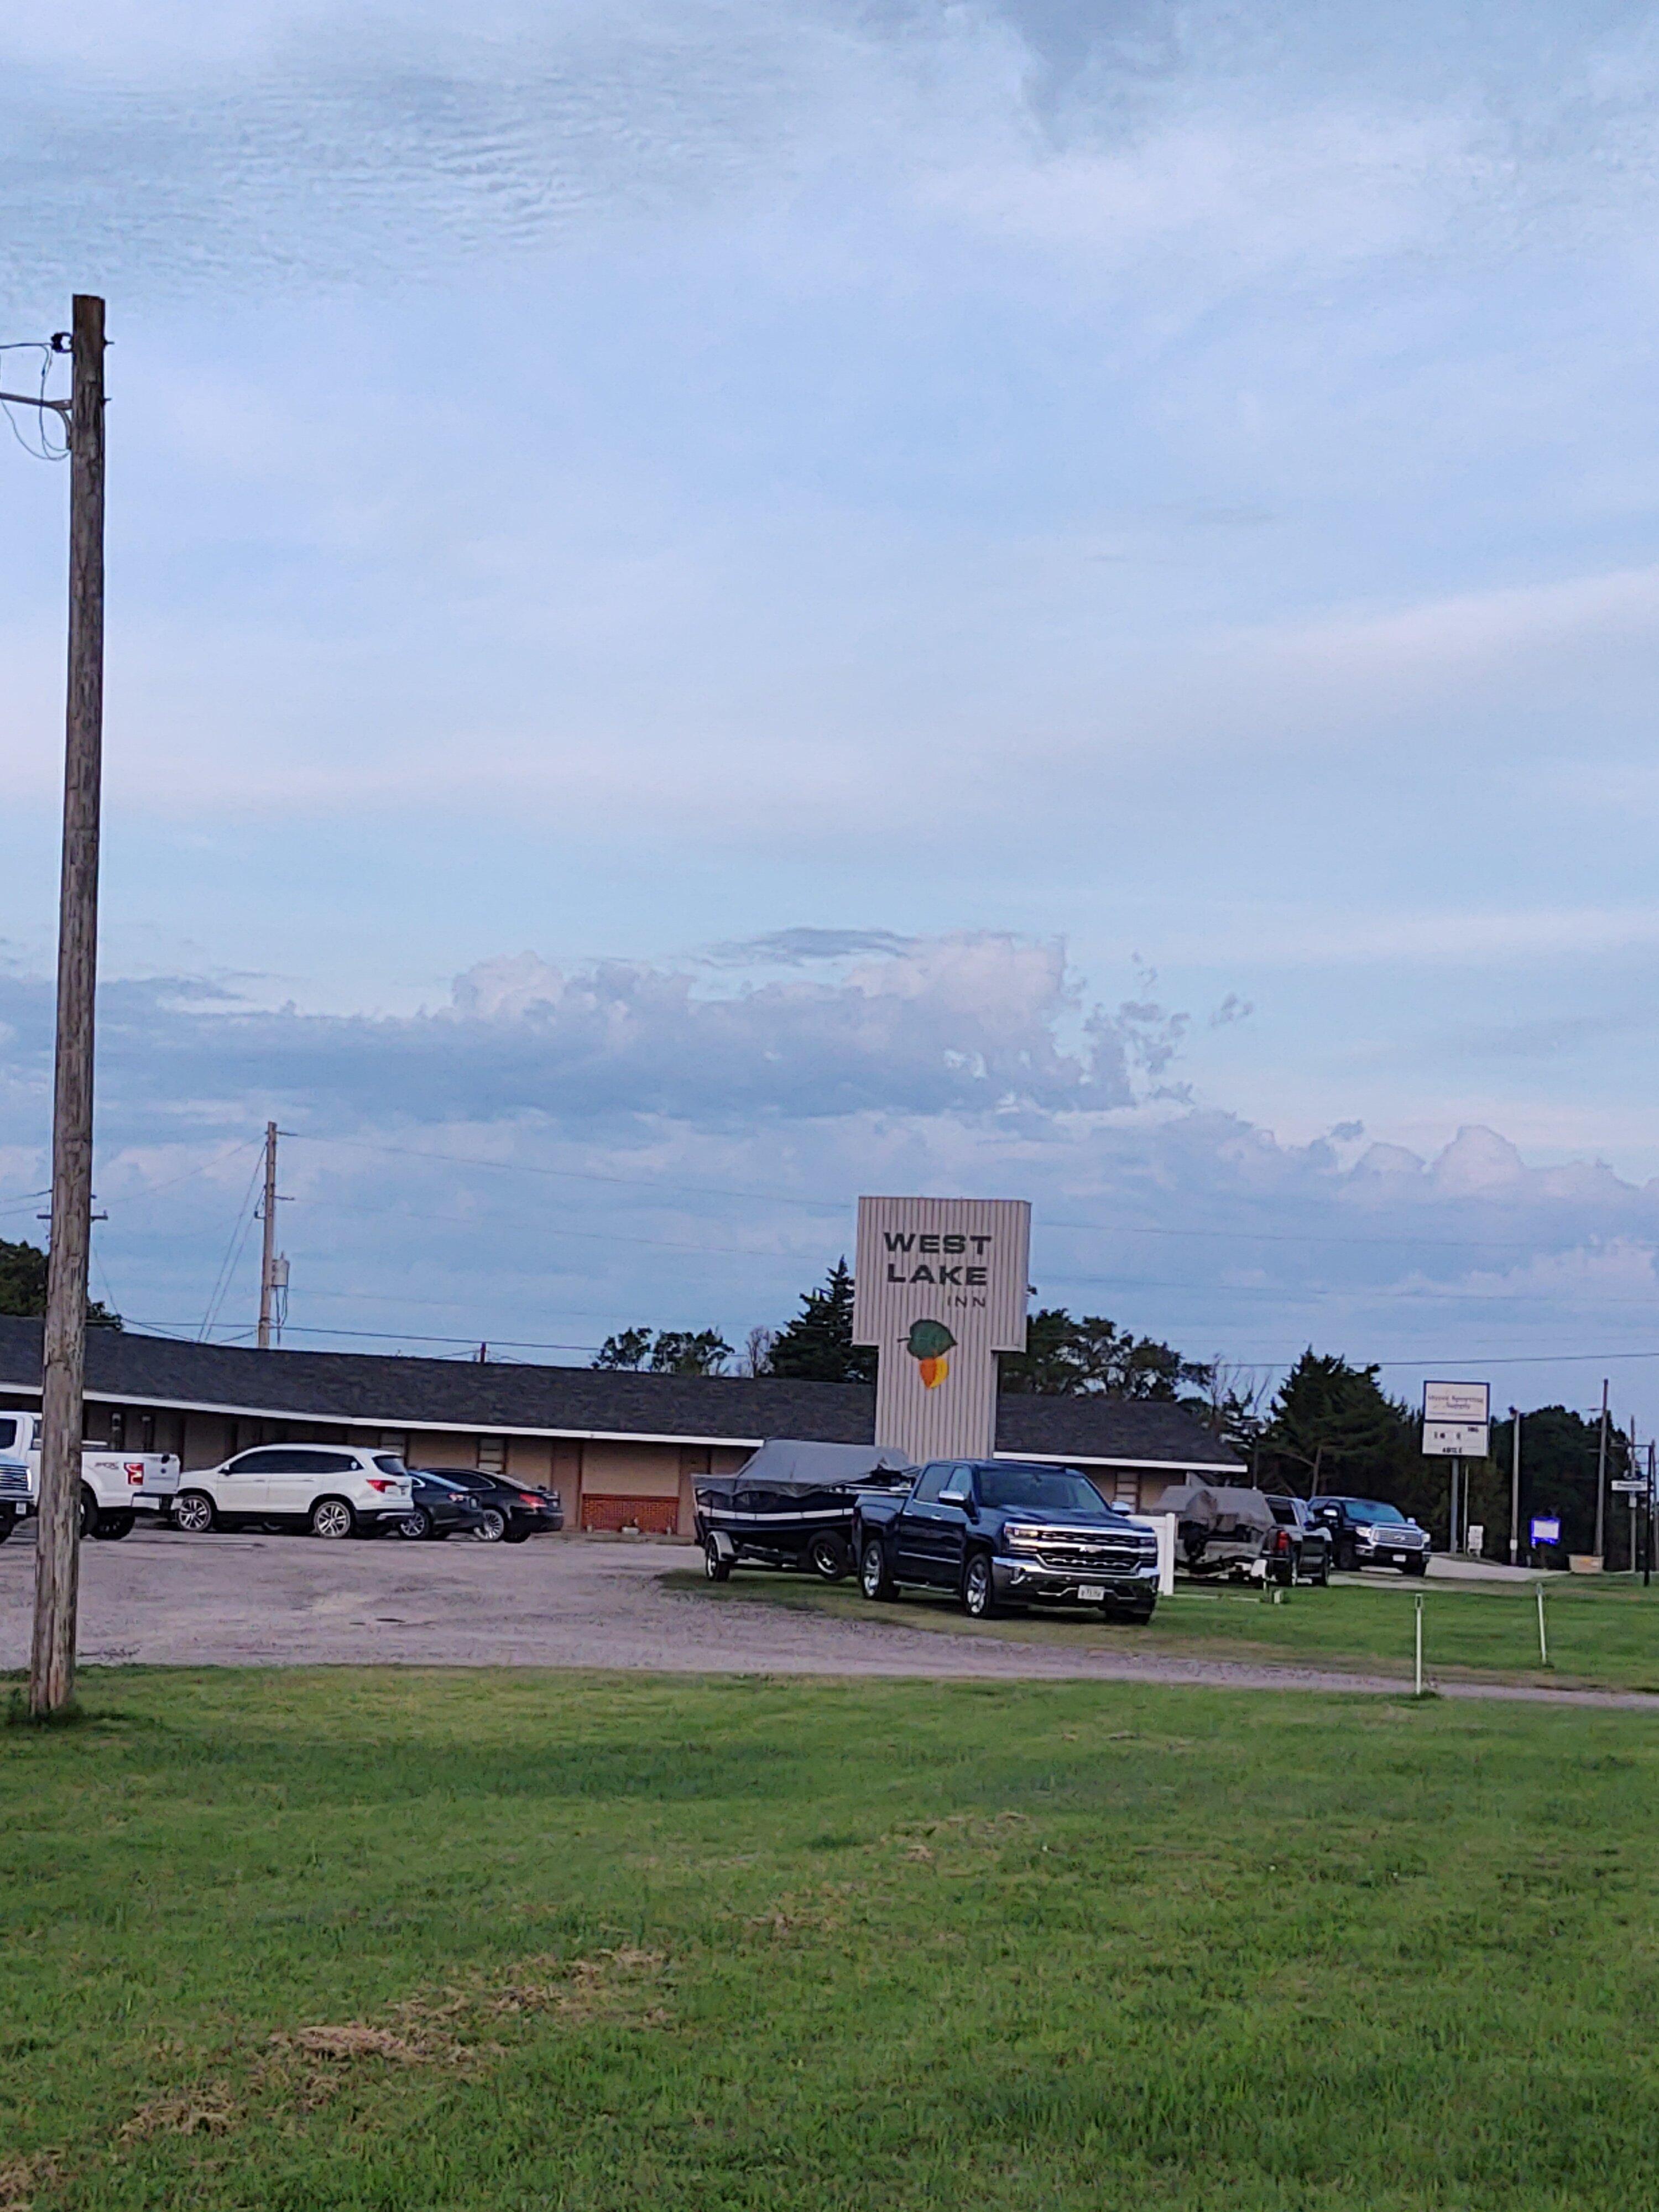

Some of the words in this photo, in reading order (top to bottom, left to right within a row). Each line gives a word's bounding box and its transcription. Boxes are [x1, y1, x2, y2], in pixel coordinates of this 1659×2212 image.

[884, 1232, 992, 1255] WEST
[887, 1263, 987, 1286] LAKE
[947, 1296, 985, 1307] INN
